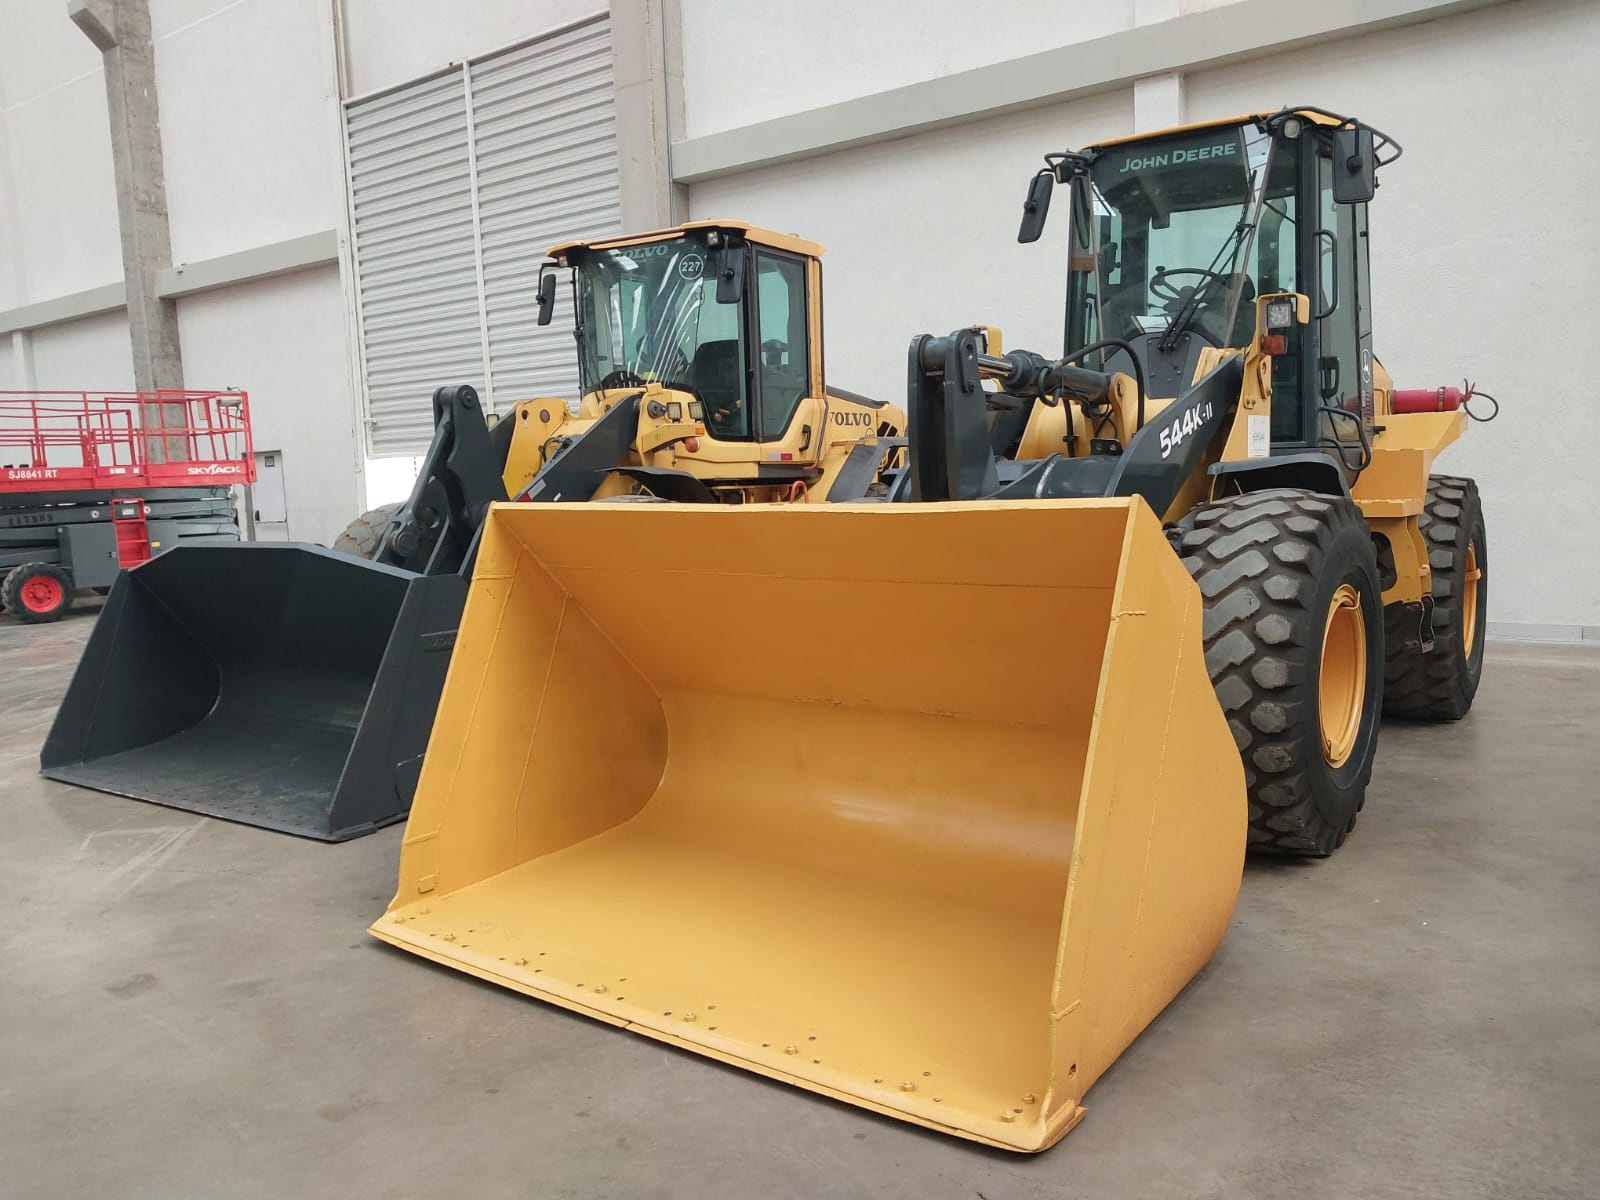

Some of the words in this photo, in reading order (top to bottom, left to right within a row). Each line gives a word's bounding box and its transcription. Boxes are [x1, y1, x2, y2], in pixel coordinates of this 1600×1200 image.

[1119, 153, 1169, 173] JOHN
[1172, 142, 1237, 164] DEERE
[615, 244, 668, 260] OLVO
[681, 261, 701, 272] 227
[44, 469, 58, 479] RT
[187, 463, 241, 475] SKYJACK
